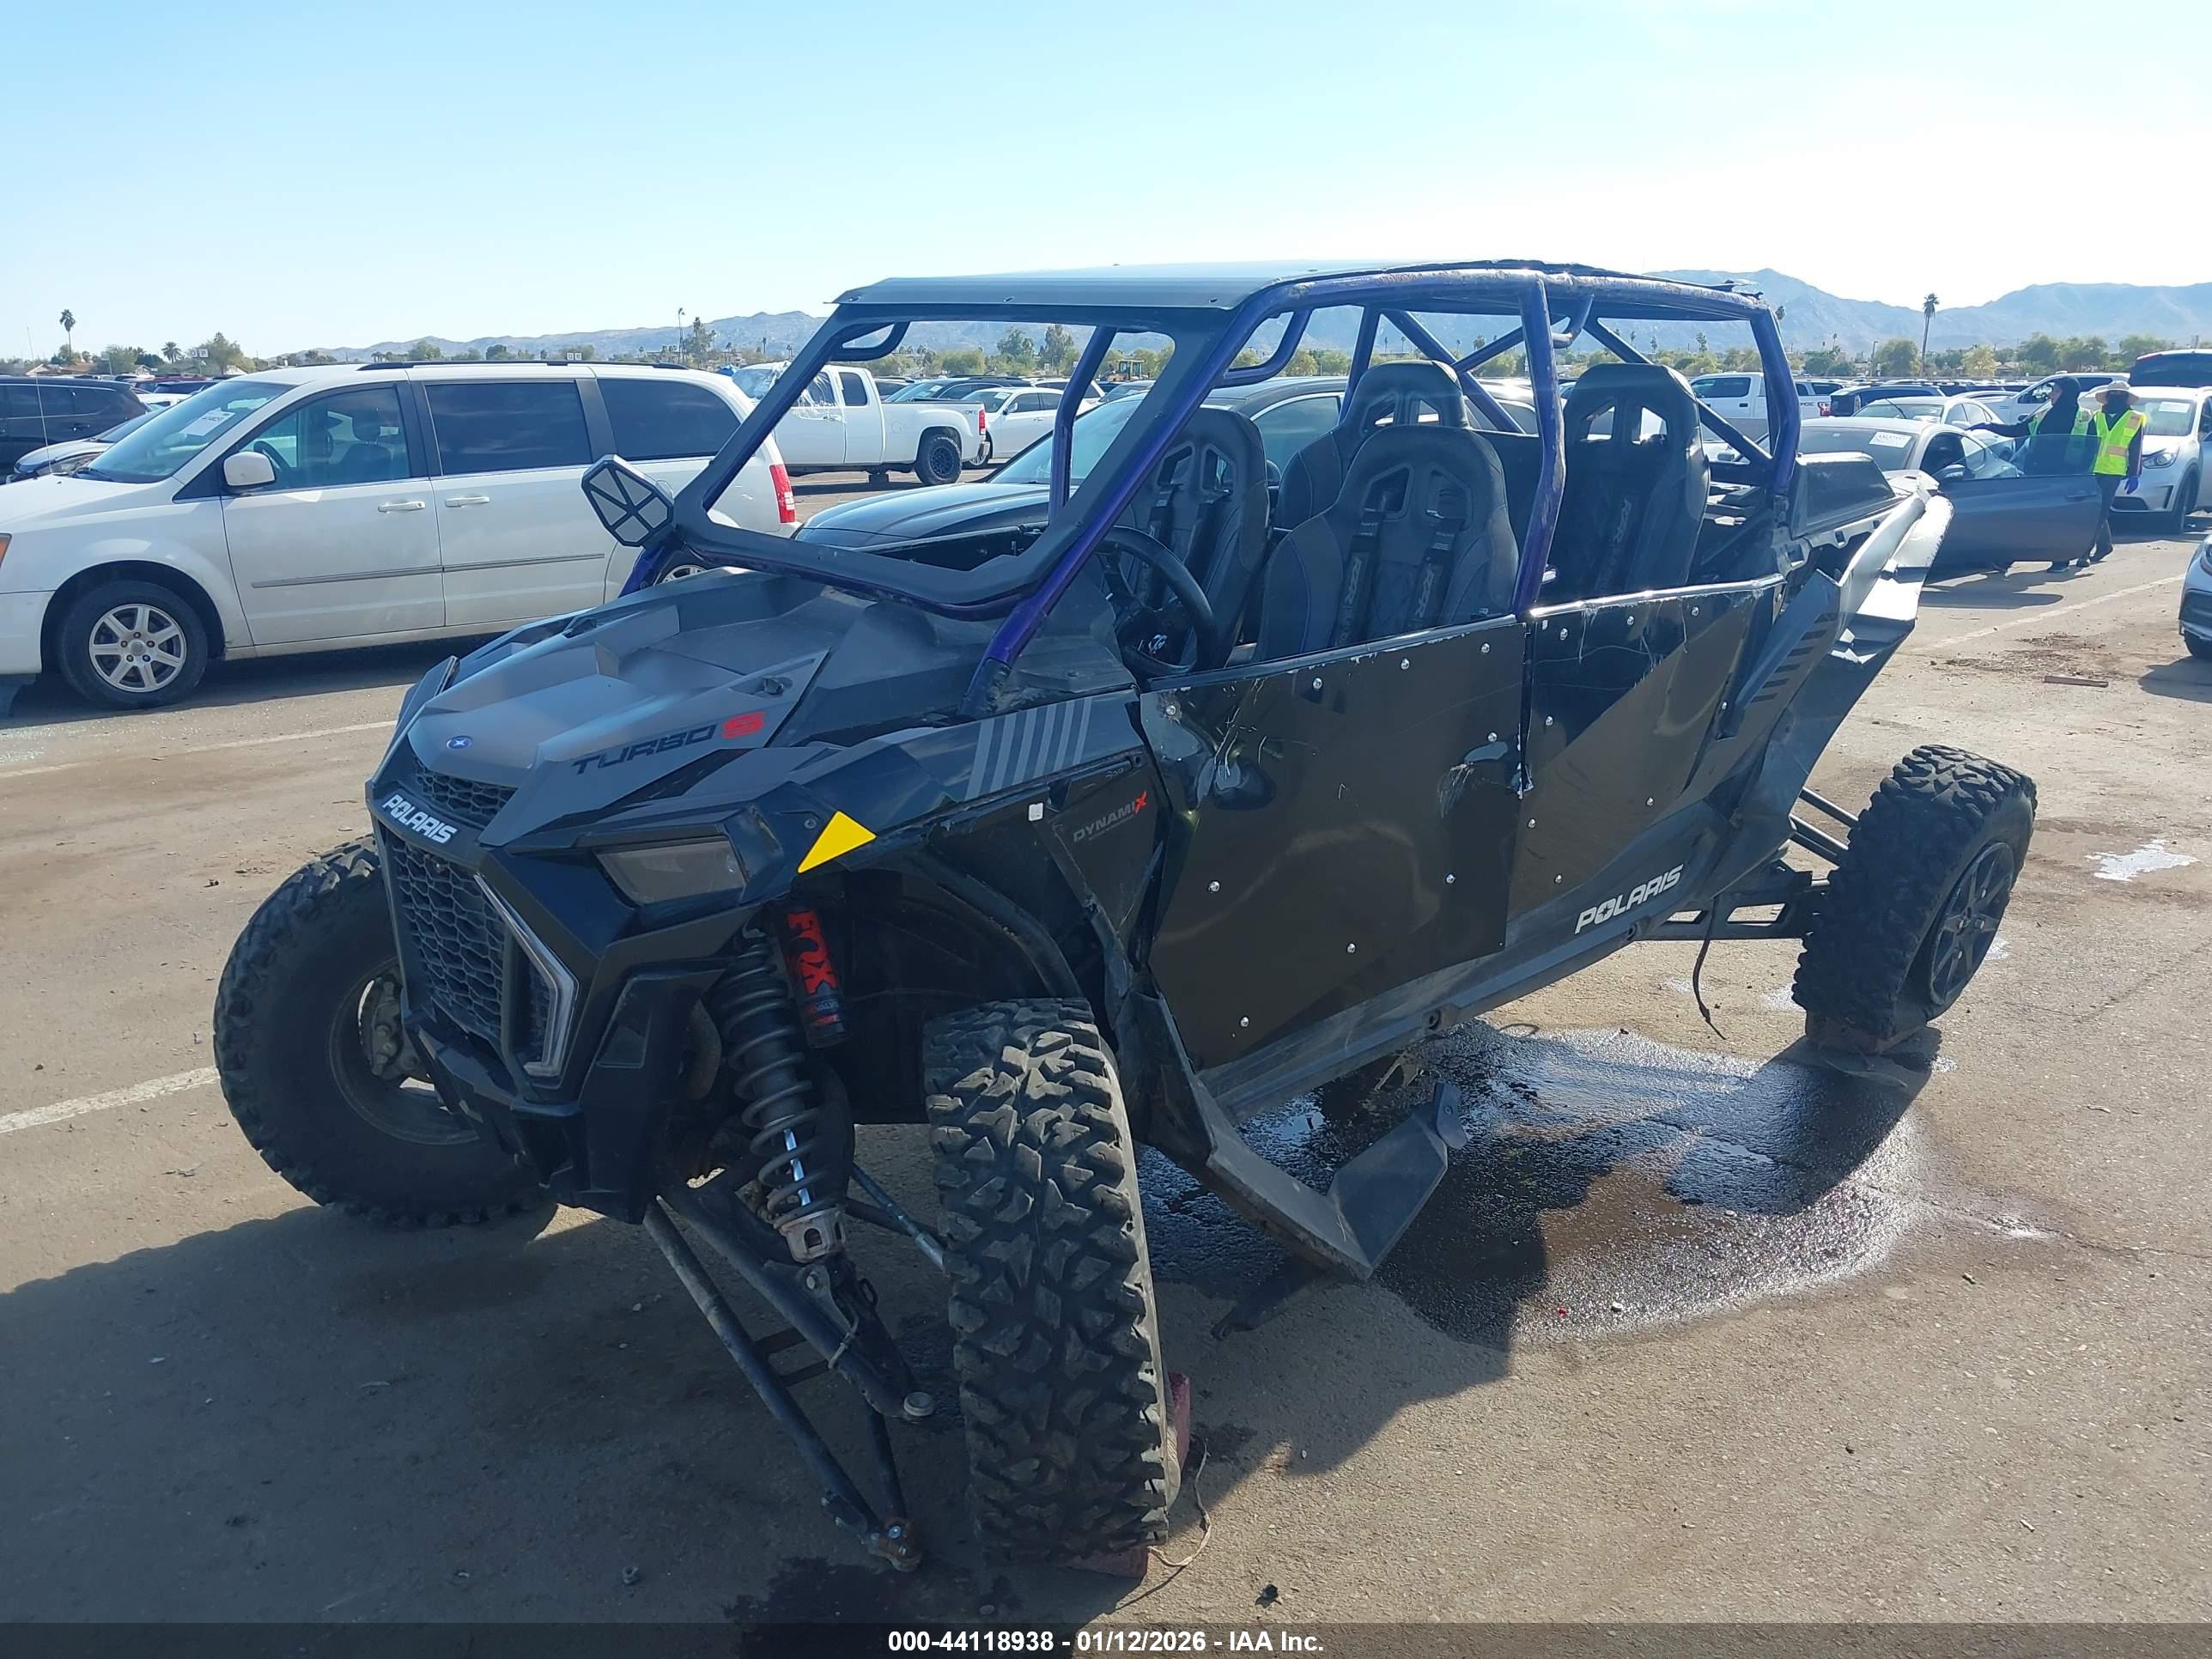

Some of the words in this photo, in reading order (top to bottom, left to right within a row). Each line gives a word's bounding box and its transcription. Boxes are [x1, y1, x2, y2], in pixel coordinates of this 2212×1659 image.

[570, 723, 718, 775] TURBO
[722, 711, 767, 739] S
[382, 793, 458, 844] POLARIS
[1073, 789, 1147, 843] DYNAMIX
[1574, 864, 1684, 935] POLARIS
[787, 910, 839, 996] FOX
